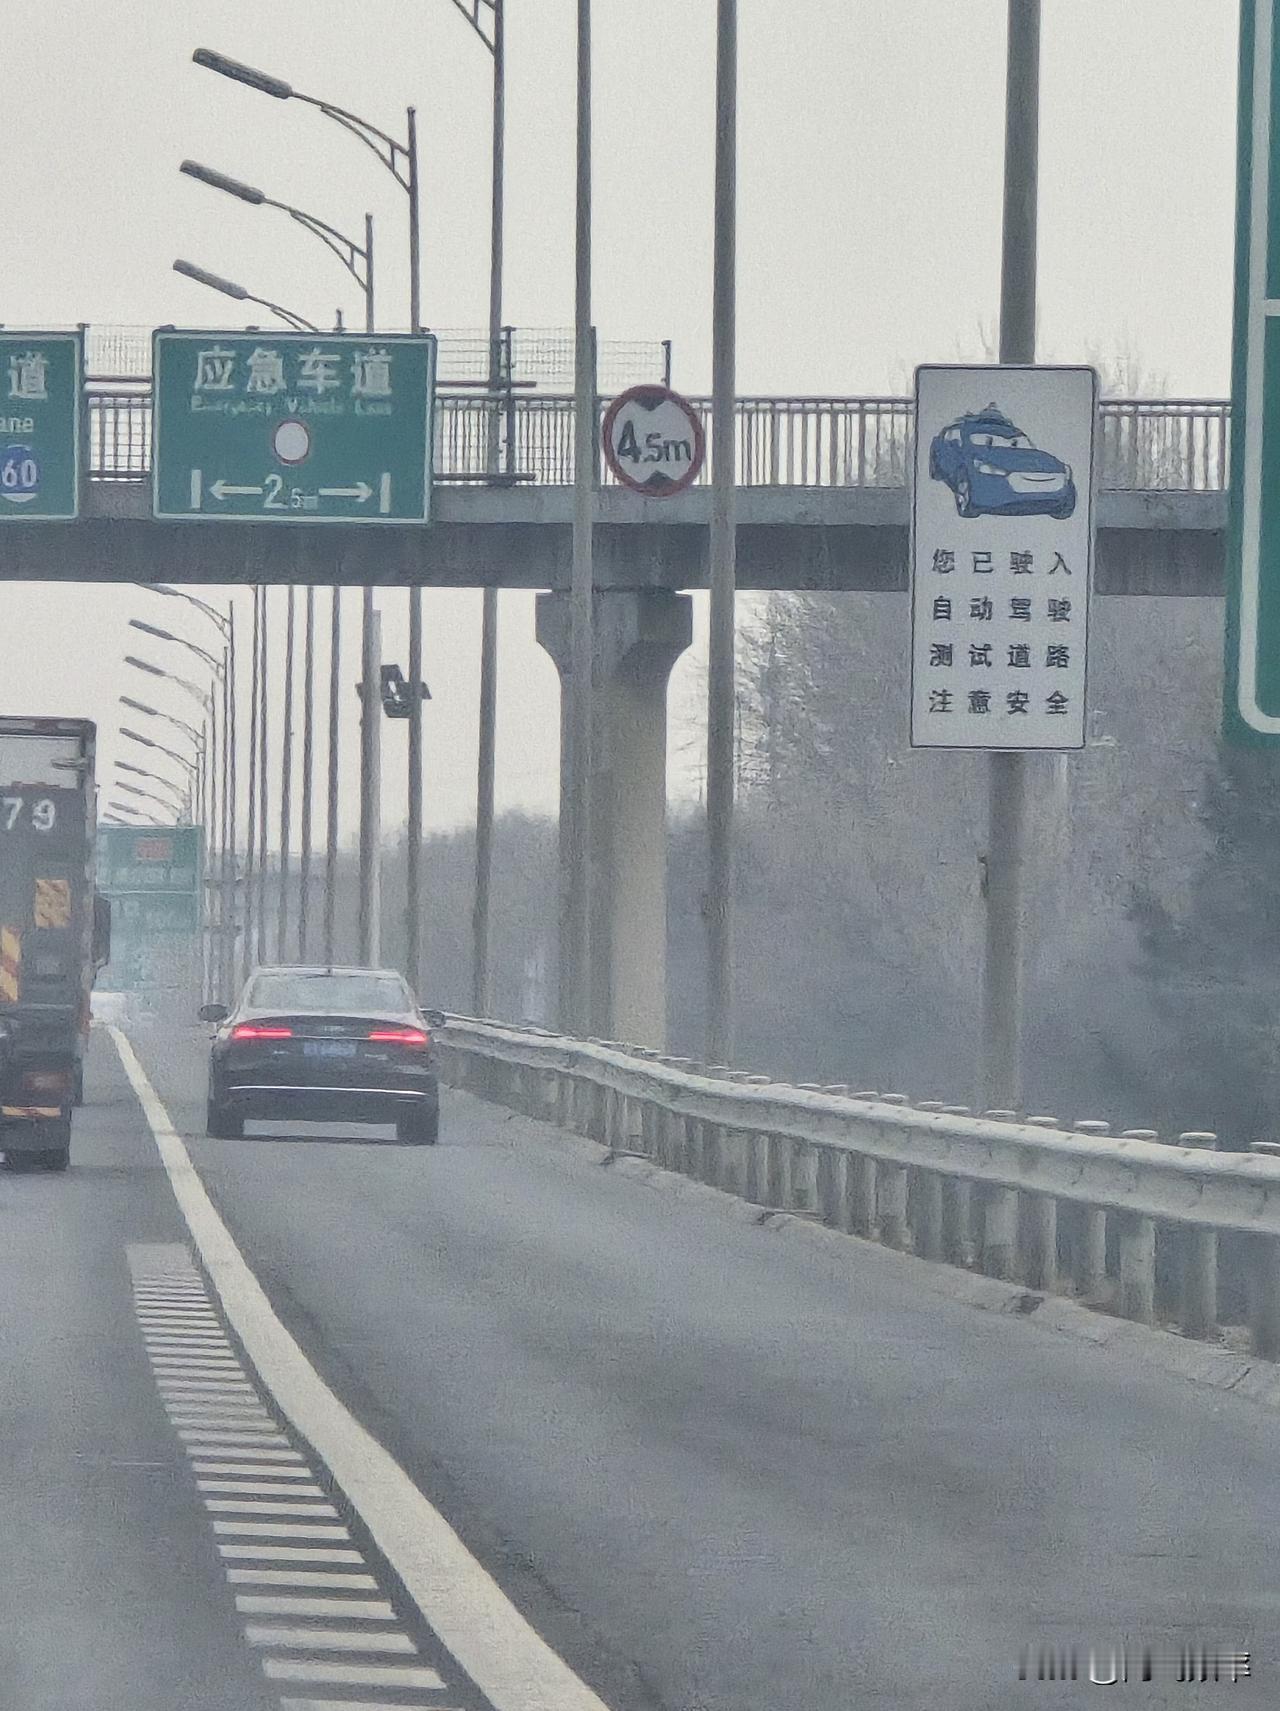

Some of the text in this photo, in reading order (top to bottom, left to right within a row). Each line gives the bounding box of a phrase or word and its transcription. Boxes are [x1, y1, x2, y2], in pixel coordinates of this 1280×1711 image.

[8, 351, 49, 400] 道
[194, 344, 393, 396] 应急车道
[2, 459, 38, 488] 60
[932, 548, 1072, 575] 您已驶入
[932, 595, 1072, 622] 自动驾驶
[929, 643, 1070, 668] 测试道路
[929, 689, 1069, 715] 注意安全
